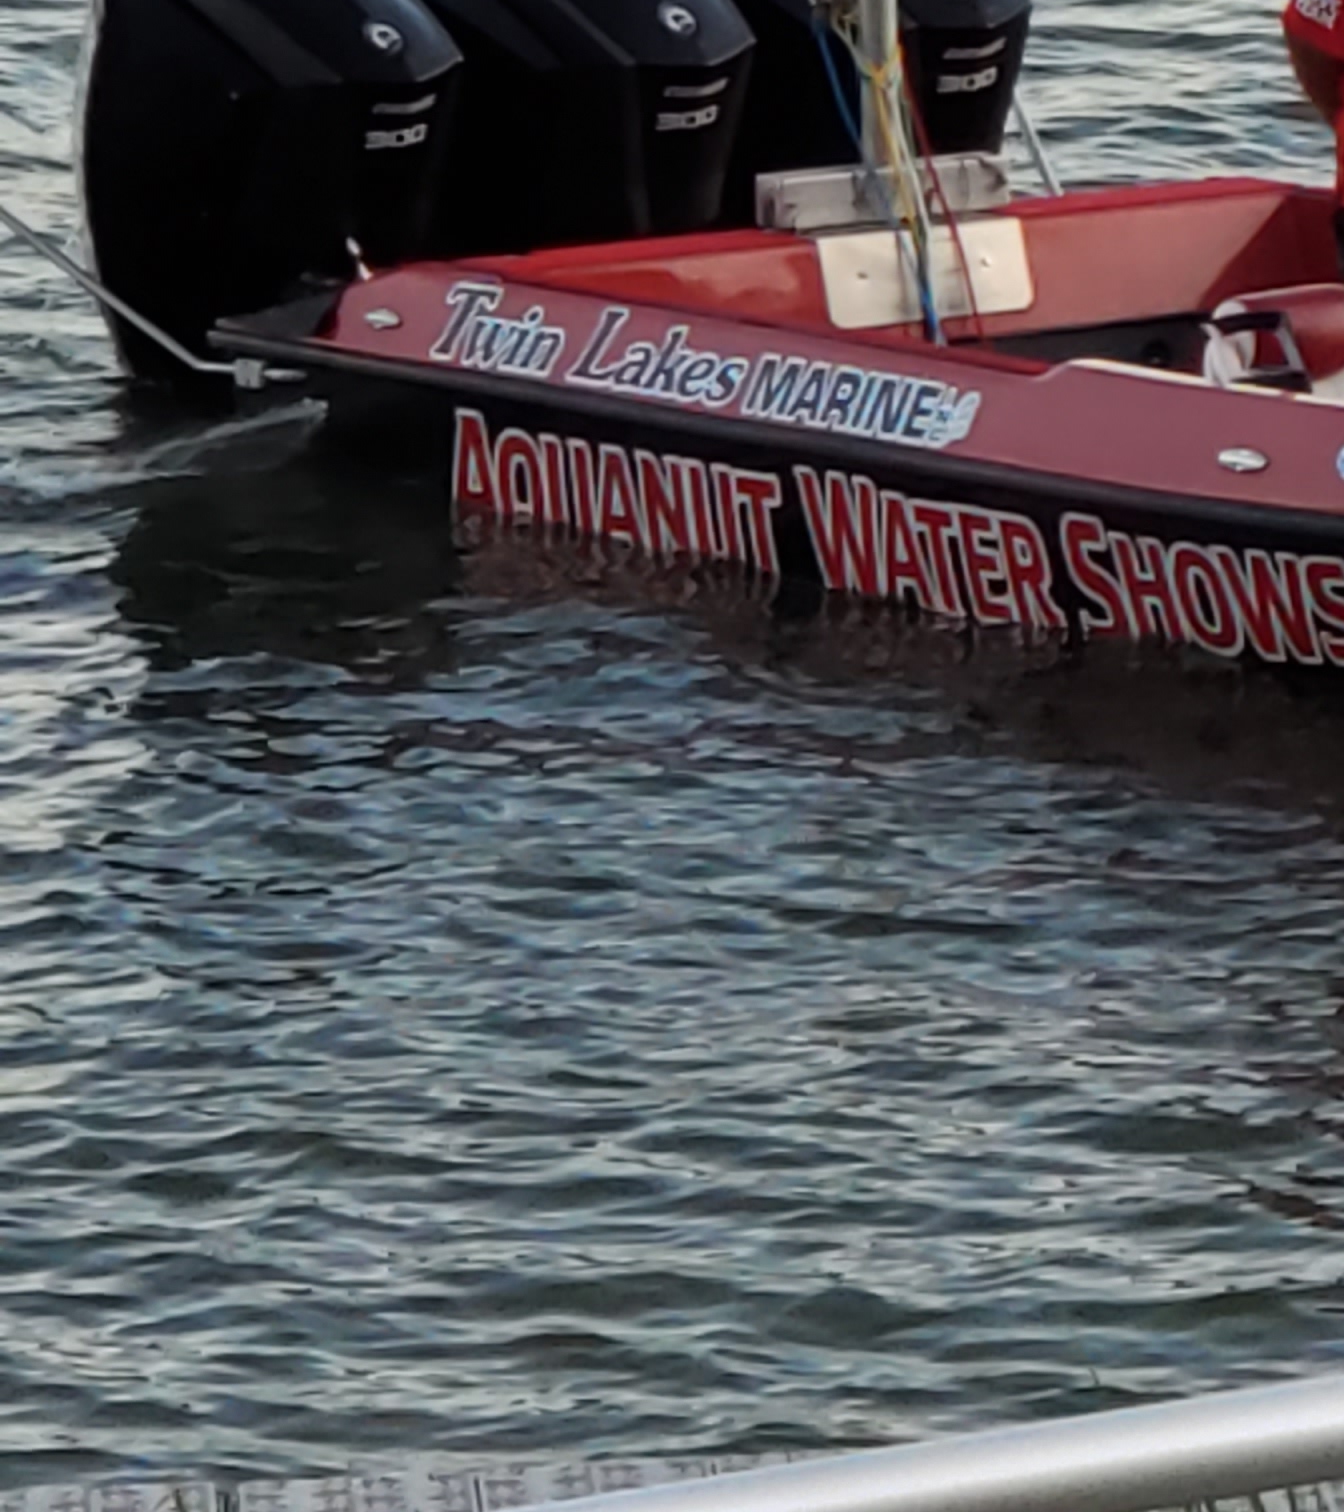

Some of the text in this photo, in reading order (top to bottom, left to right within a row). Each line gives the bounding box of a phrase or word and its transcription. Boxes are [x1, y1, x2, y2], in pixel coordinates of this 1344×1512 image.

[430, 281, 564, 373] Twin
[566, 306, 749, 407] Lakes
[741, 353, 944, 446] MARINE
[794, 464, 1068, 630] WATER
